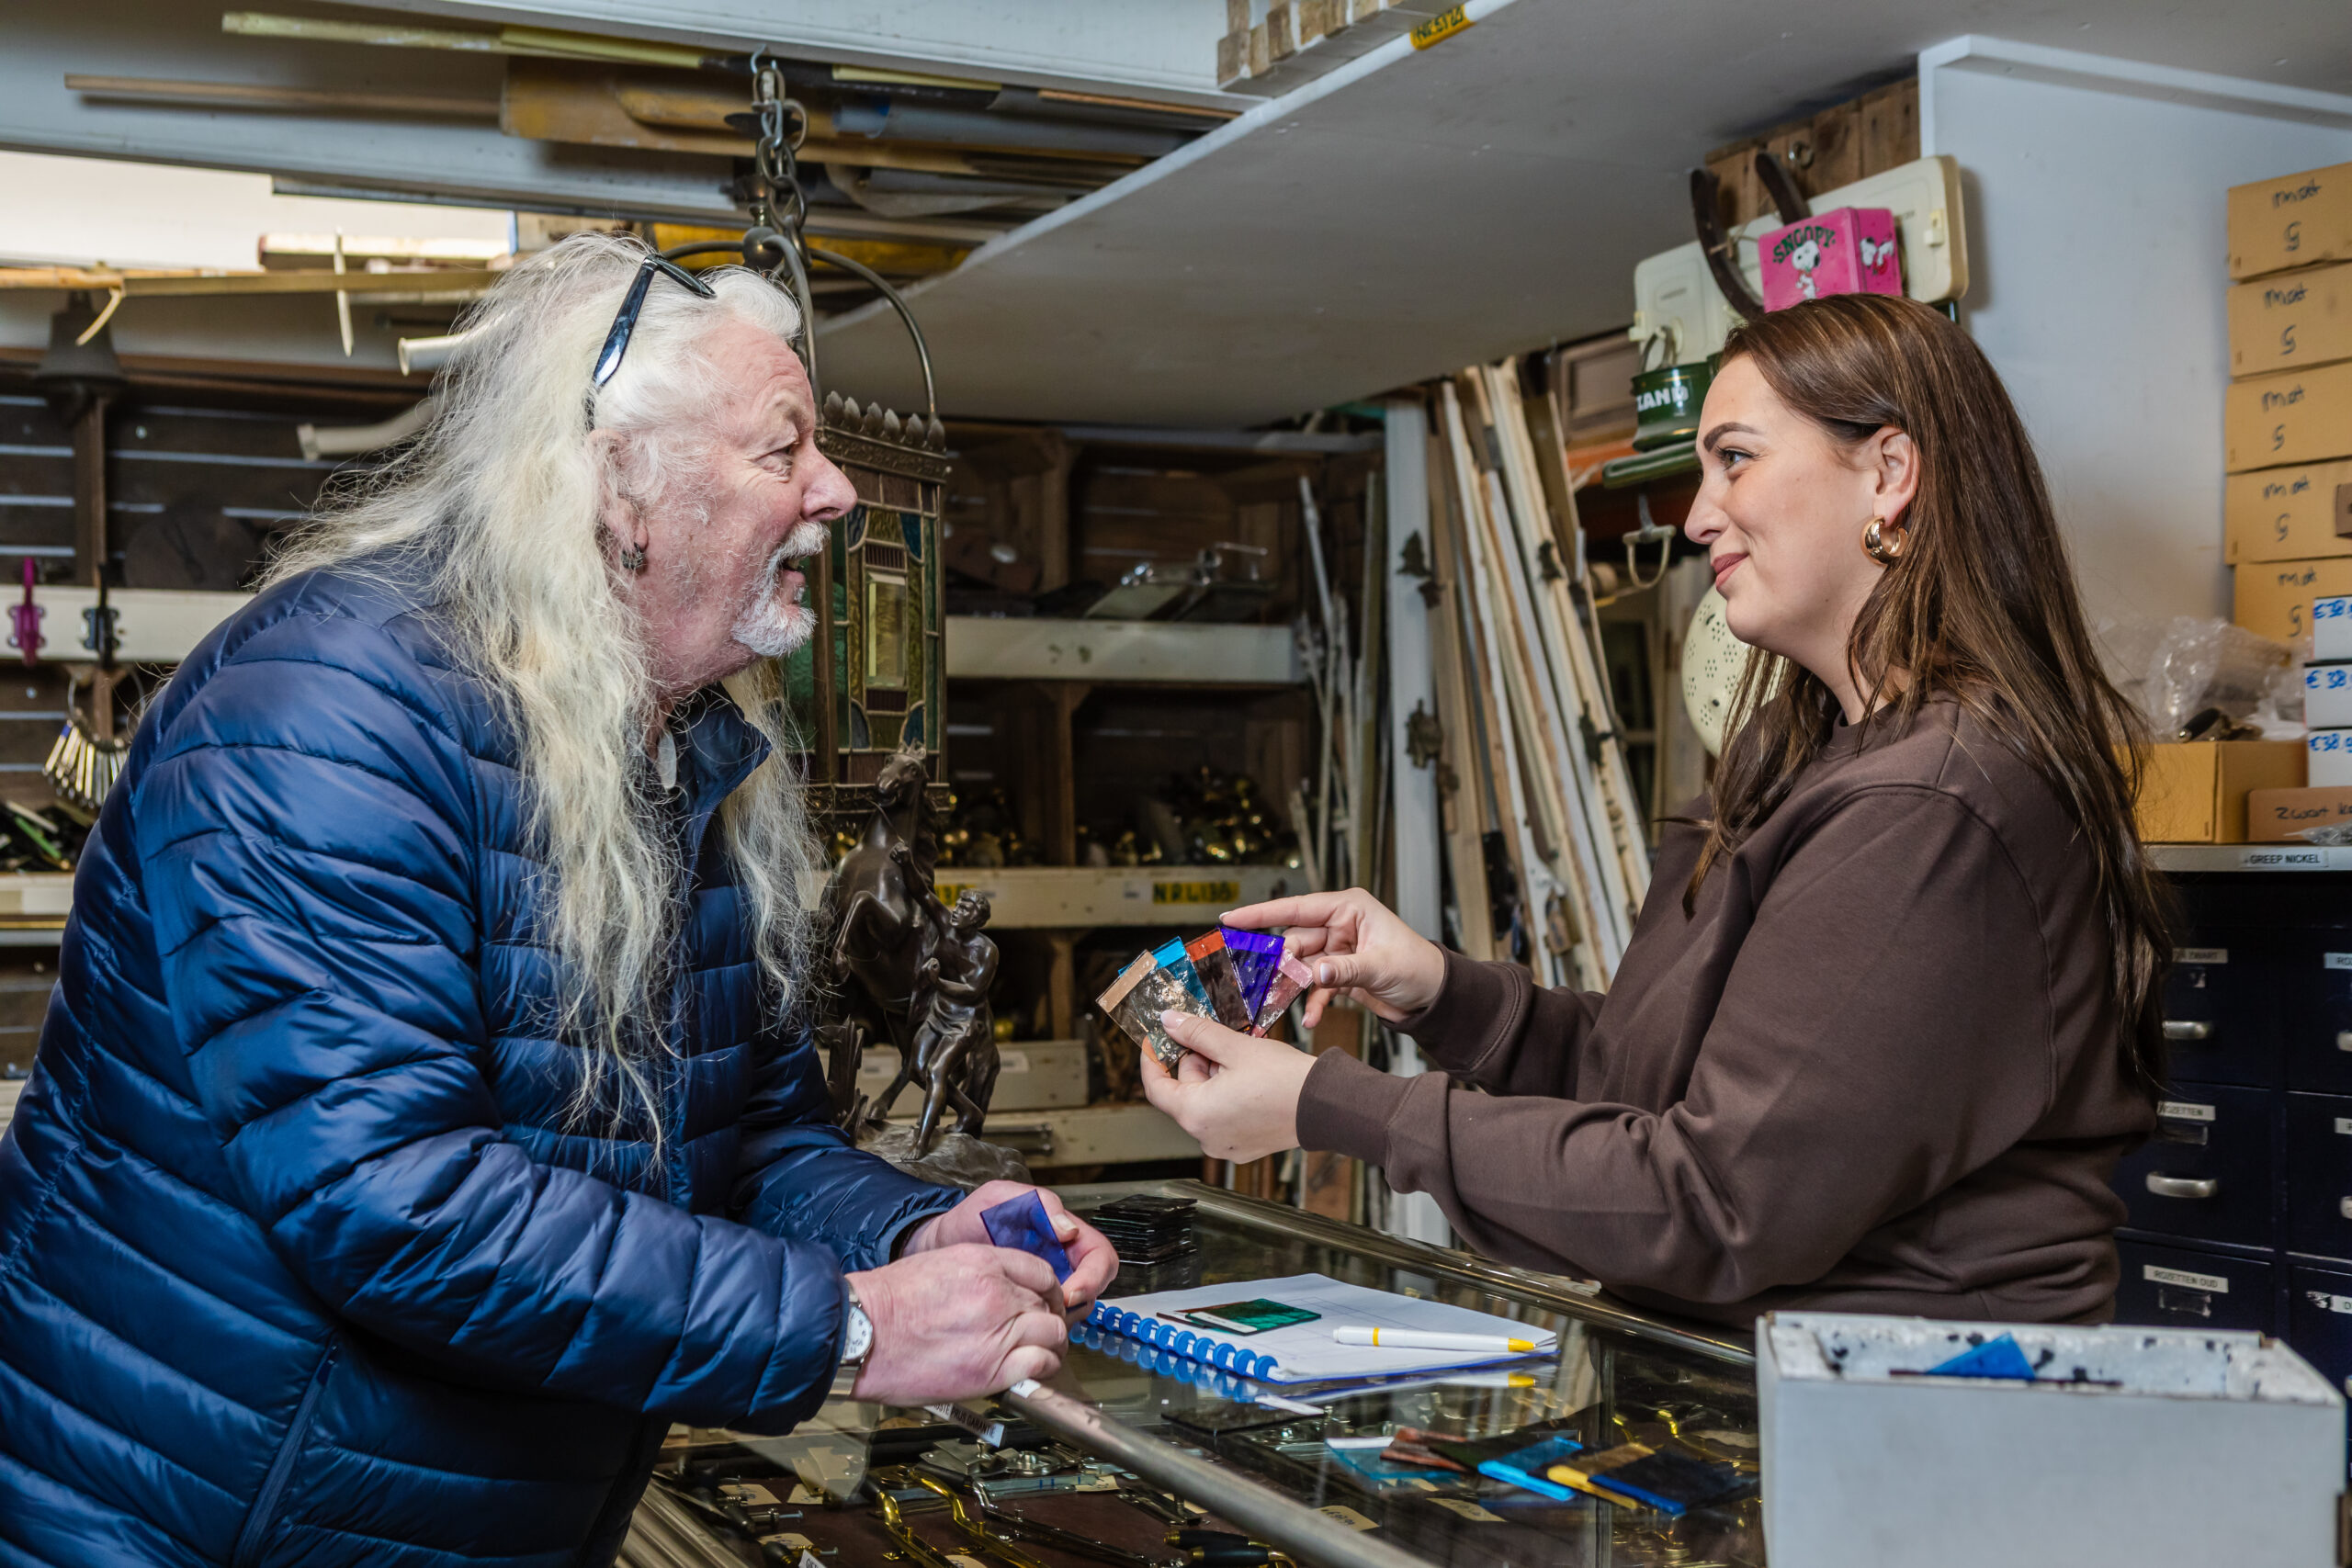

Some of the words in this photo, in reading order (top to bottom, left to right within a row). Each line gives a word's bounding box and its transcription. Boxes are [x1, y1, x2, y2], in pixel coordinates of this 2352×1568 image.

[1773, 226, 1836, 264] SNOOPY
[2250, 854, 2283, 864] GREEP
[2285, 854, 2321, 863] NICKEL
[2154, 1269, 2198, 1284] ROZETTEN
[2199, 1278, 2218, 1288] OUD
